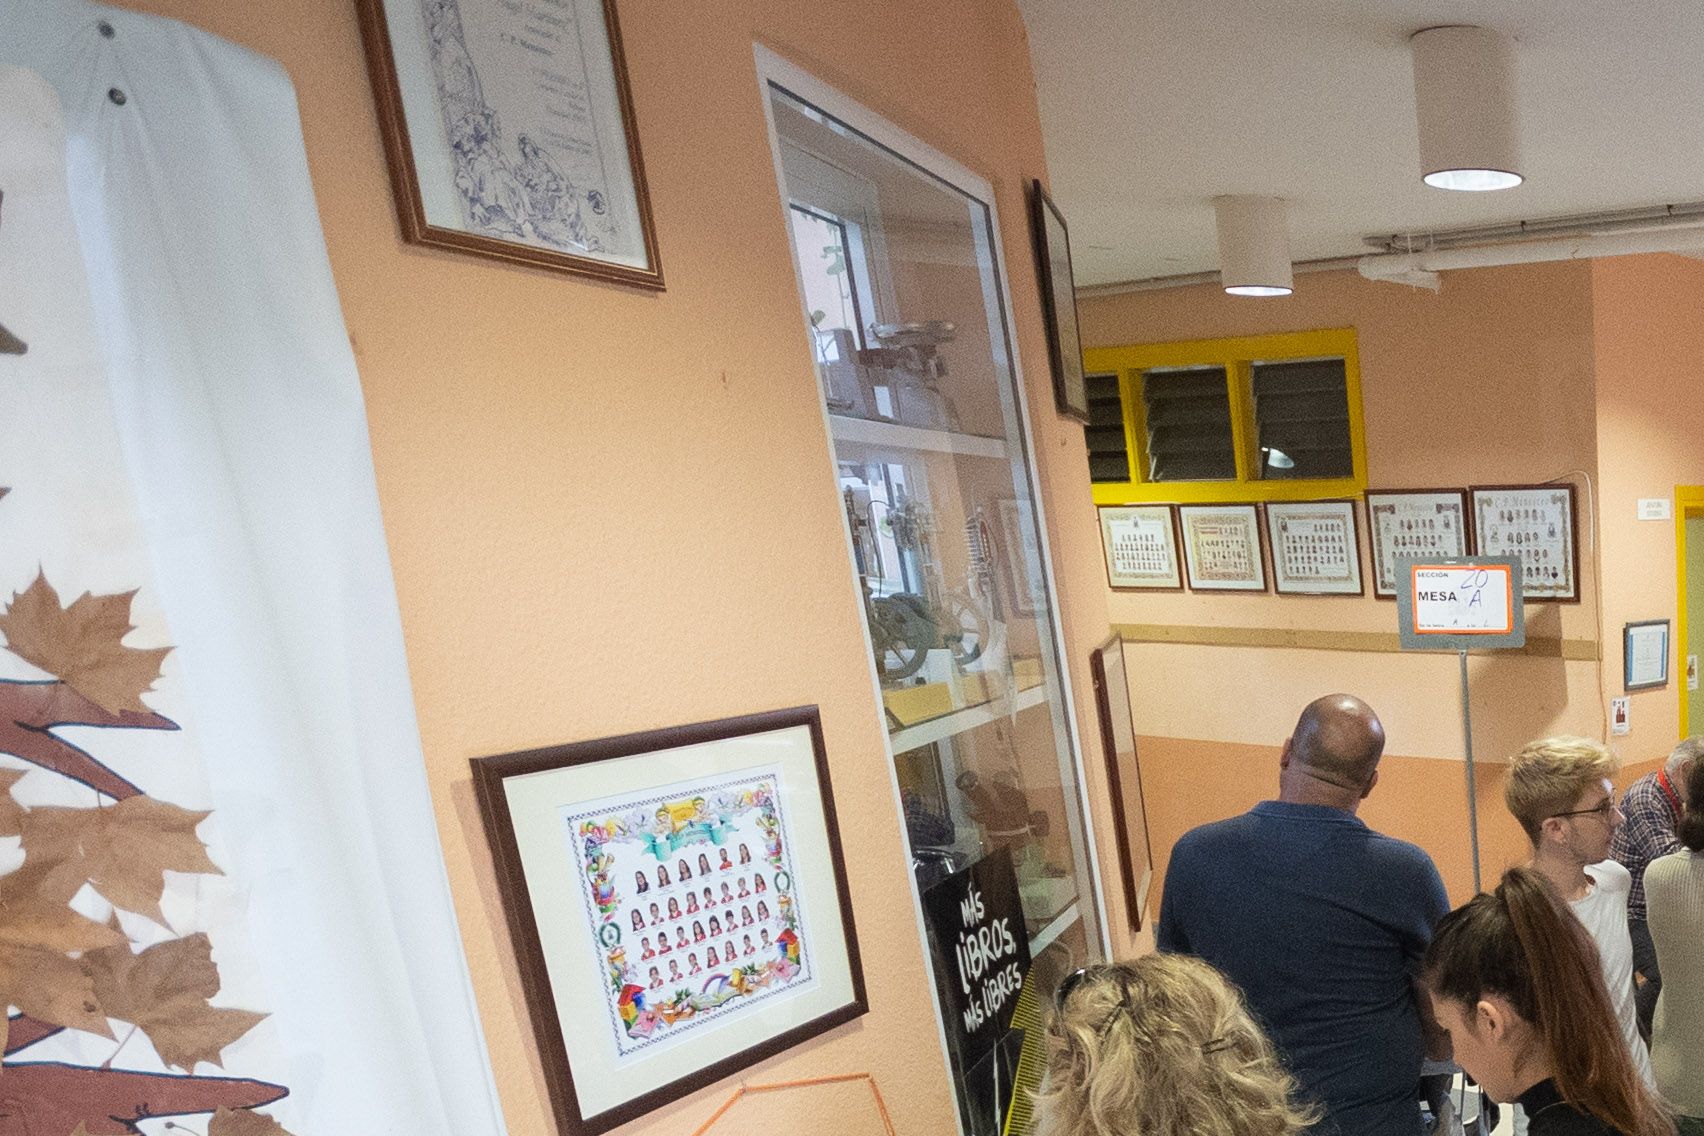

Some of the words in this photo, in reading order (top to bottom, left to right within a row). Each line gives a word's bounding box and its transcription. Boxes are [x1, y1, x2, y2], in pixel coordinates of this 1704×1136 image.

[1460, 569, 1489, 589] 20
[1418, 591, 1457, 601] MESA
[1469, 589, 1482, 608] A
[960, 881, 985, 927] MÁS
[963, 993, 984, 1033] MÁS
